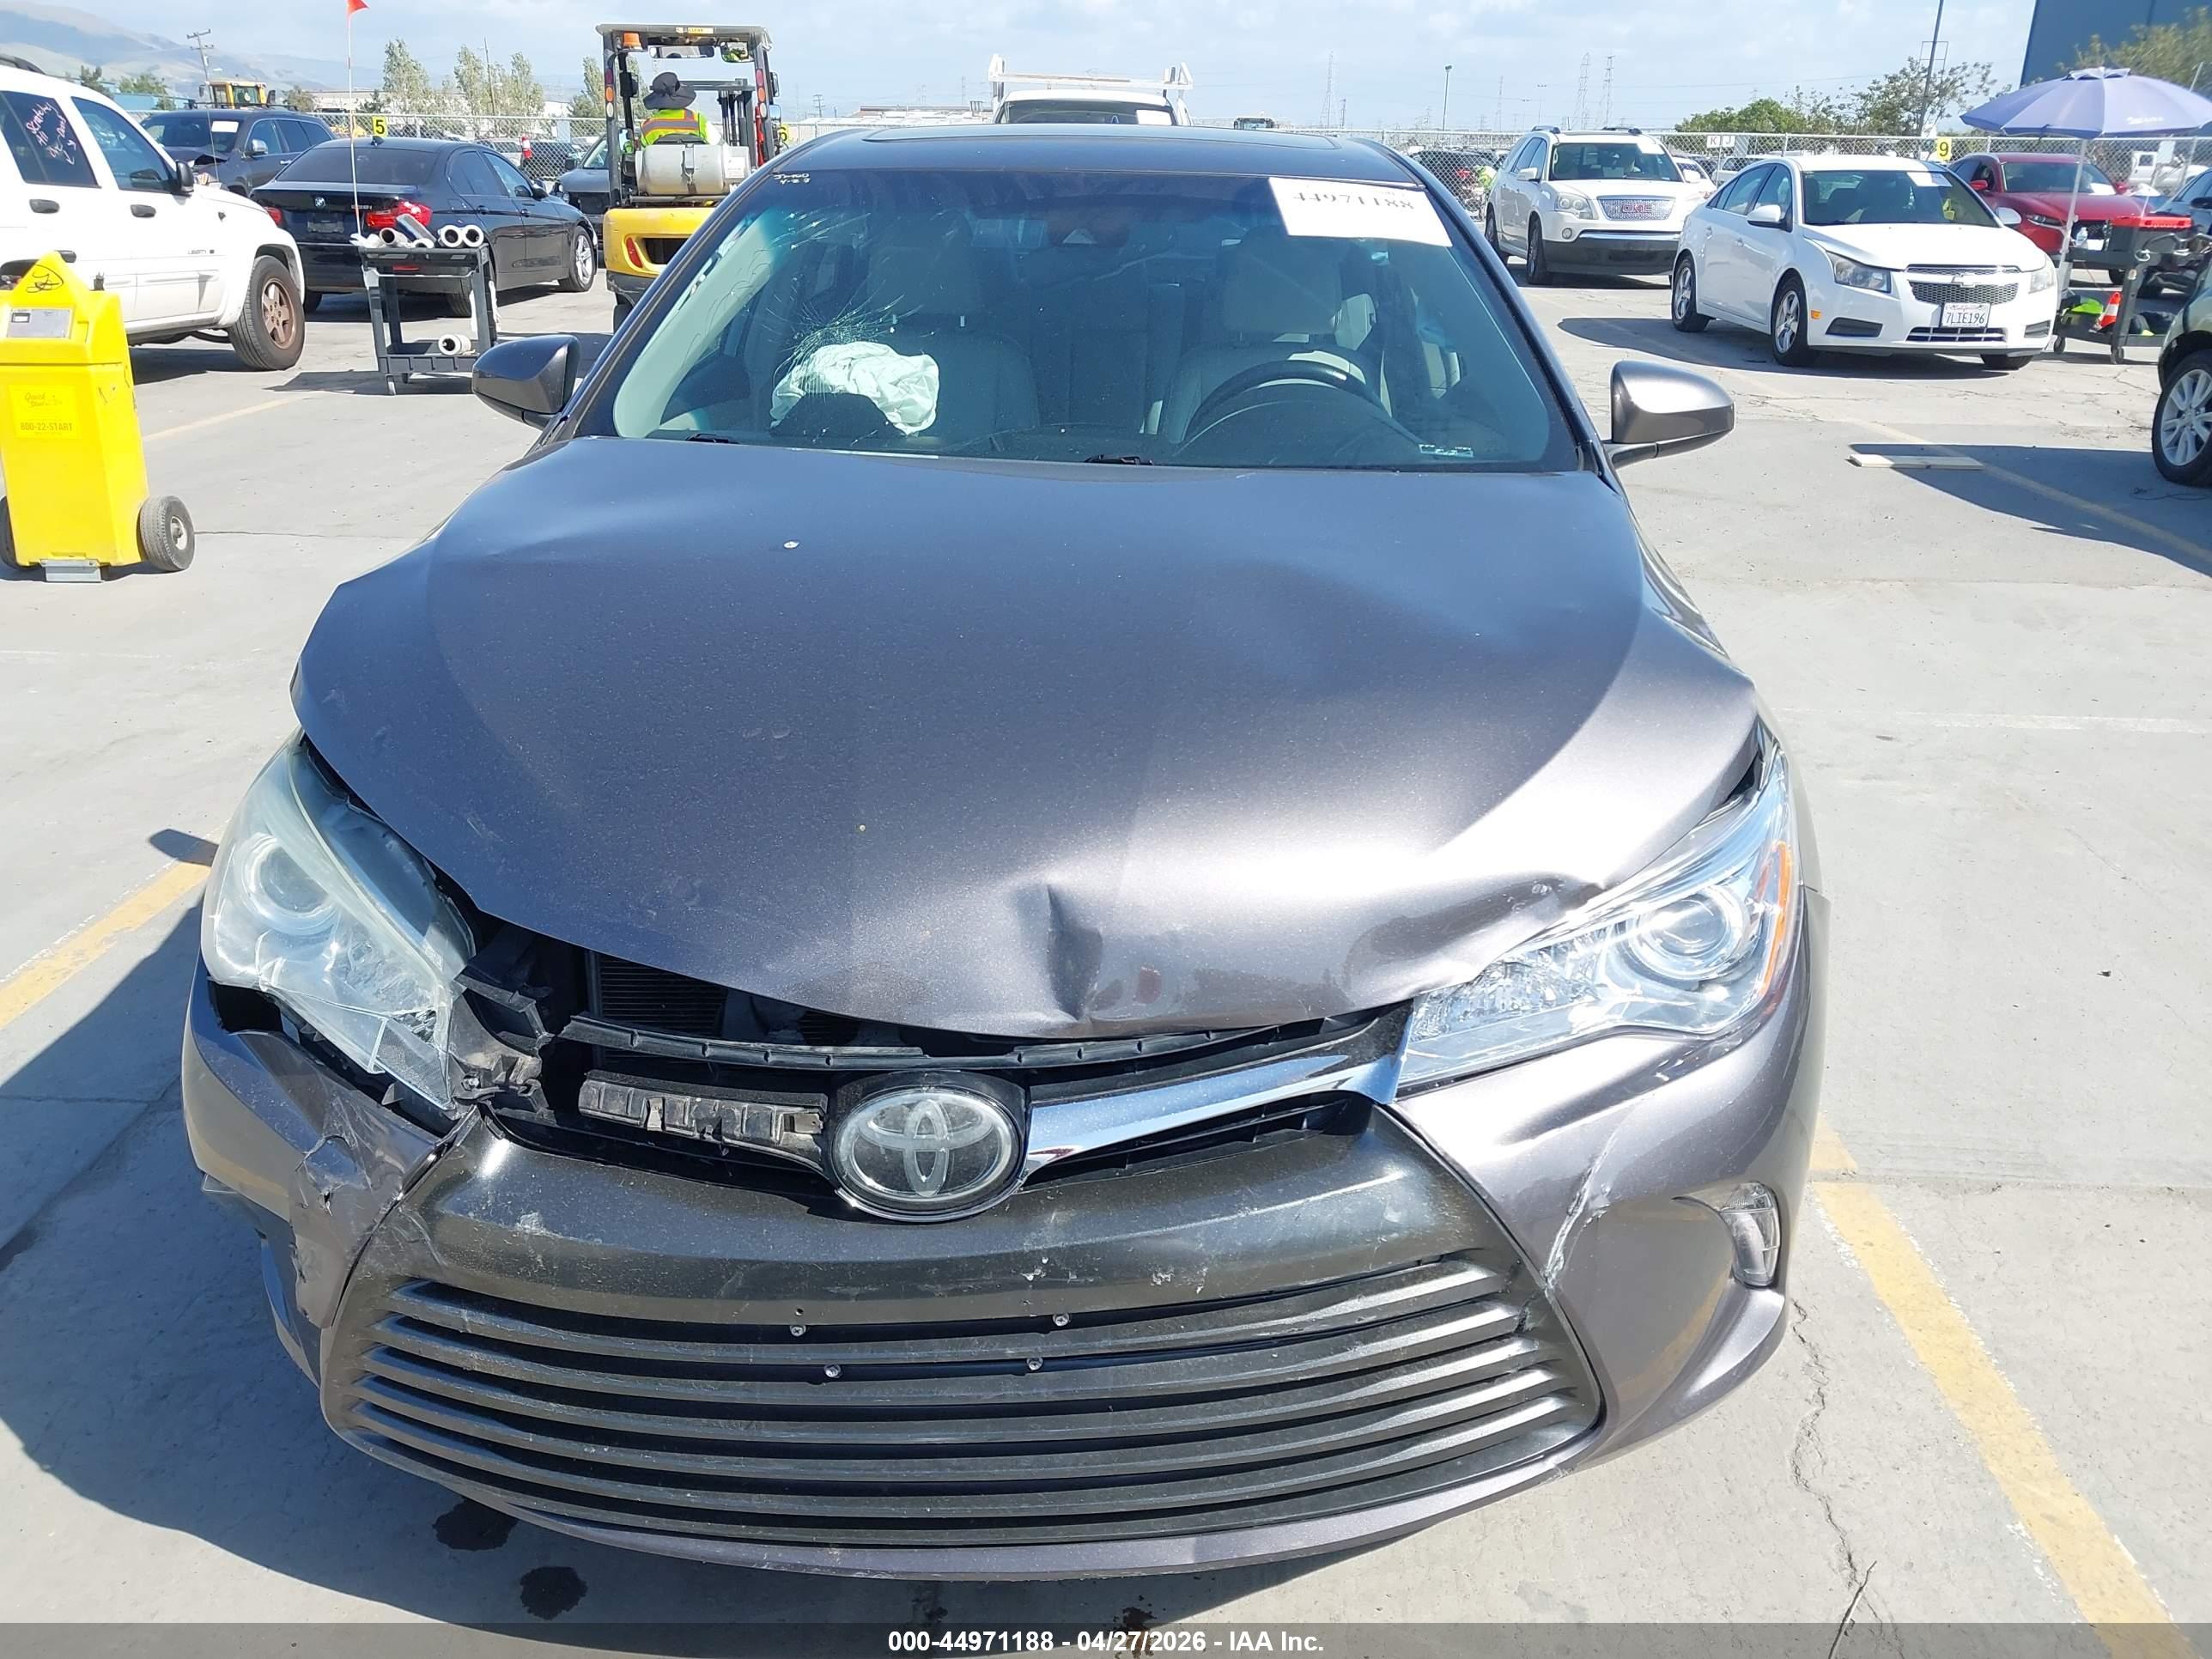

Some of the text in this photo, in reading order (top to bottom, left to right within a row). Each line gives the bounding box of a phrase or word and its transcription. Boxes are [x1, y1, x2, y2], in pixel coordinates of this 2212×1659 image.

[376, 119, 385, 134] 5
[1710, 137, 1718, 145] K
[1939, 142, 1948, 156] 9
[1946, 312, 1986, 324] 7LIE196
